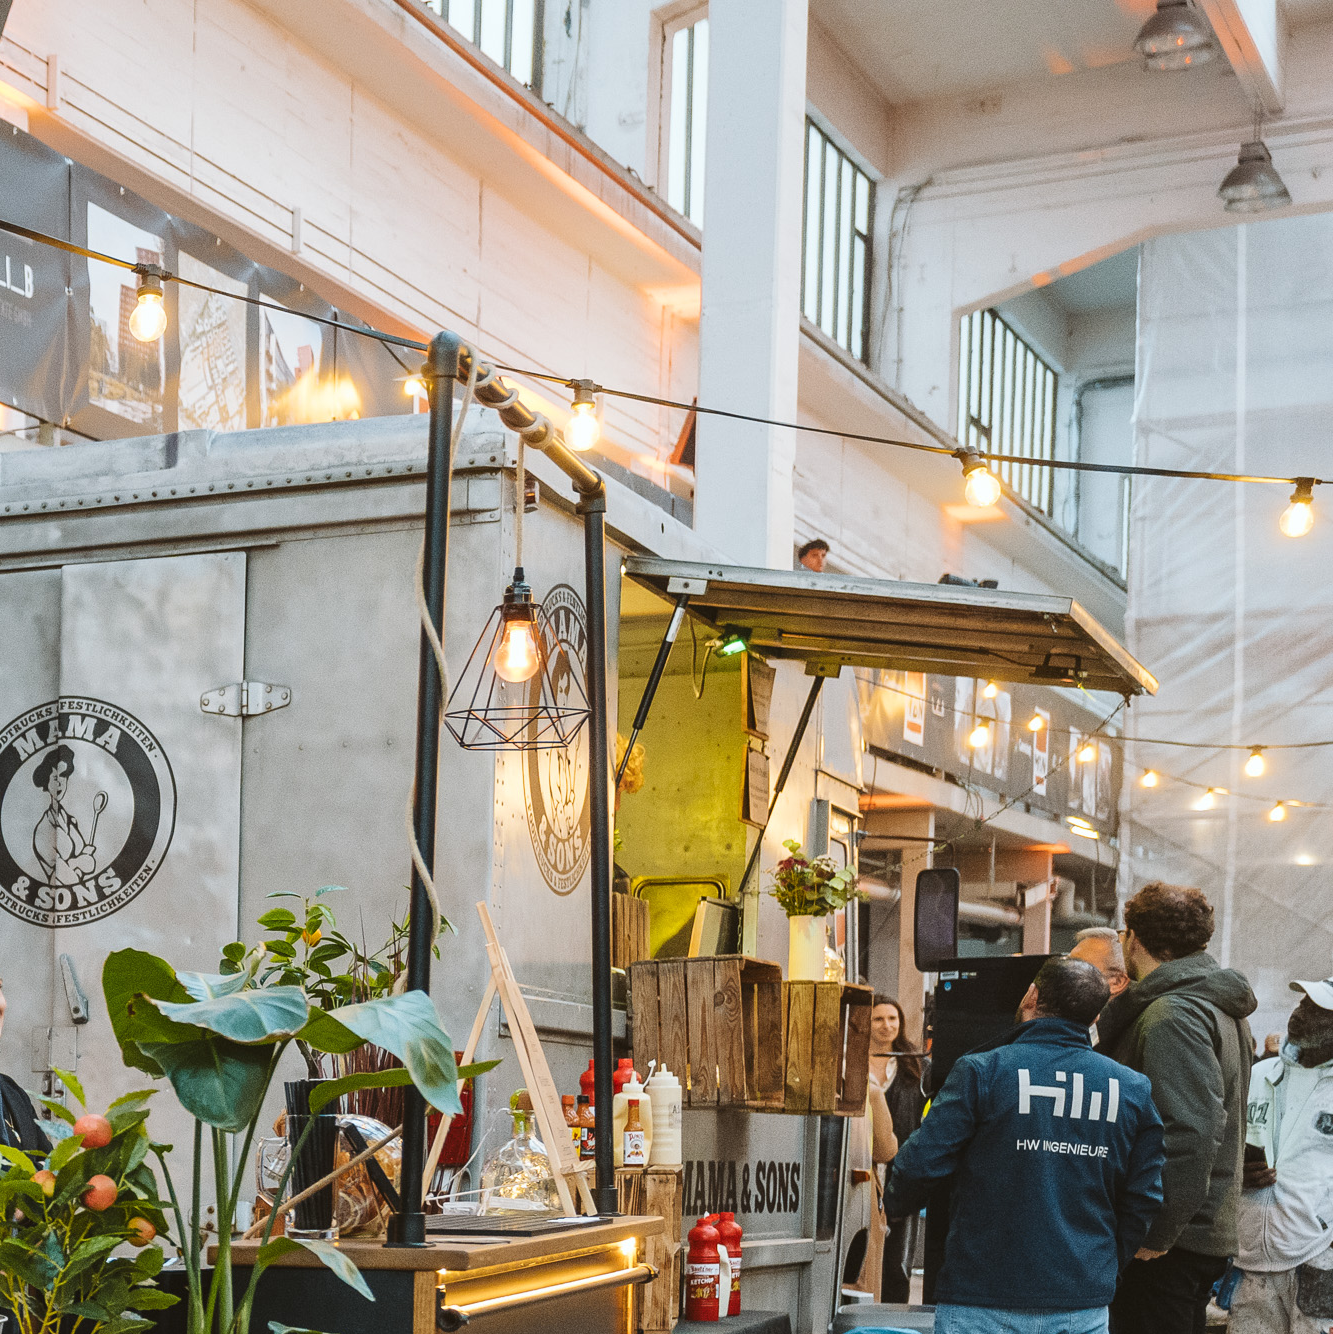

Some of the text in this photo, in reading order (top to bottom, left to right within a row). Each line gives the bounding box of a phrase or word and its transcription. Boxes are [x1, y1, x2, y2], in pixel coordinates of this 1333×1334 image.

[12, 715, 122, 762] MAMA
[59, 701, 157, 754] FESTLICHKEITEN
[547, 824, 582, 872] SONS
[12, 867, 122, 911] & SONS
[56, 867, 153, 924] FESTLICHKEITEN
[1016, 1139, 1109, 1158] HW INGENIEURE
[741, 1163, 752, 1214] &
[754, 1160, 801, 1214] SONS
